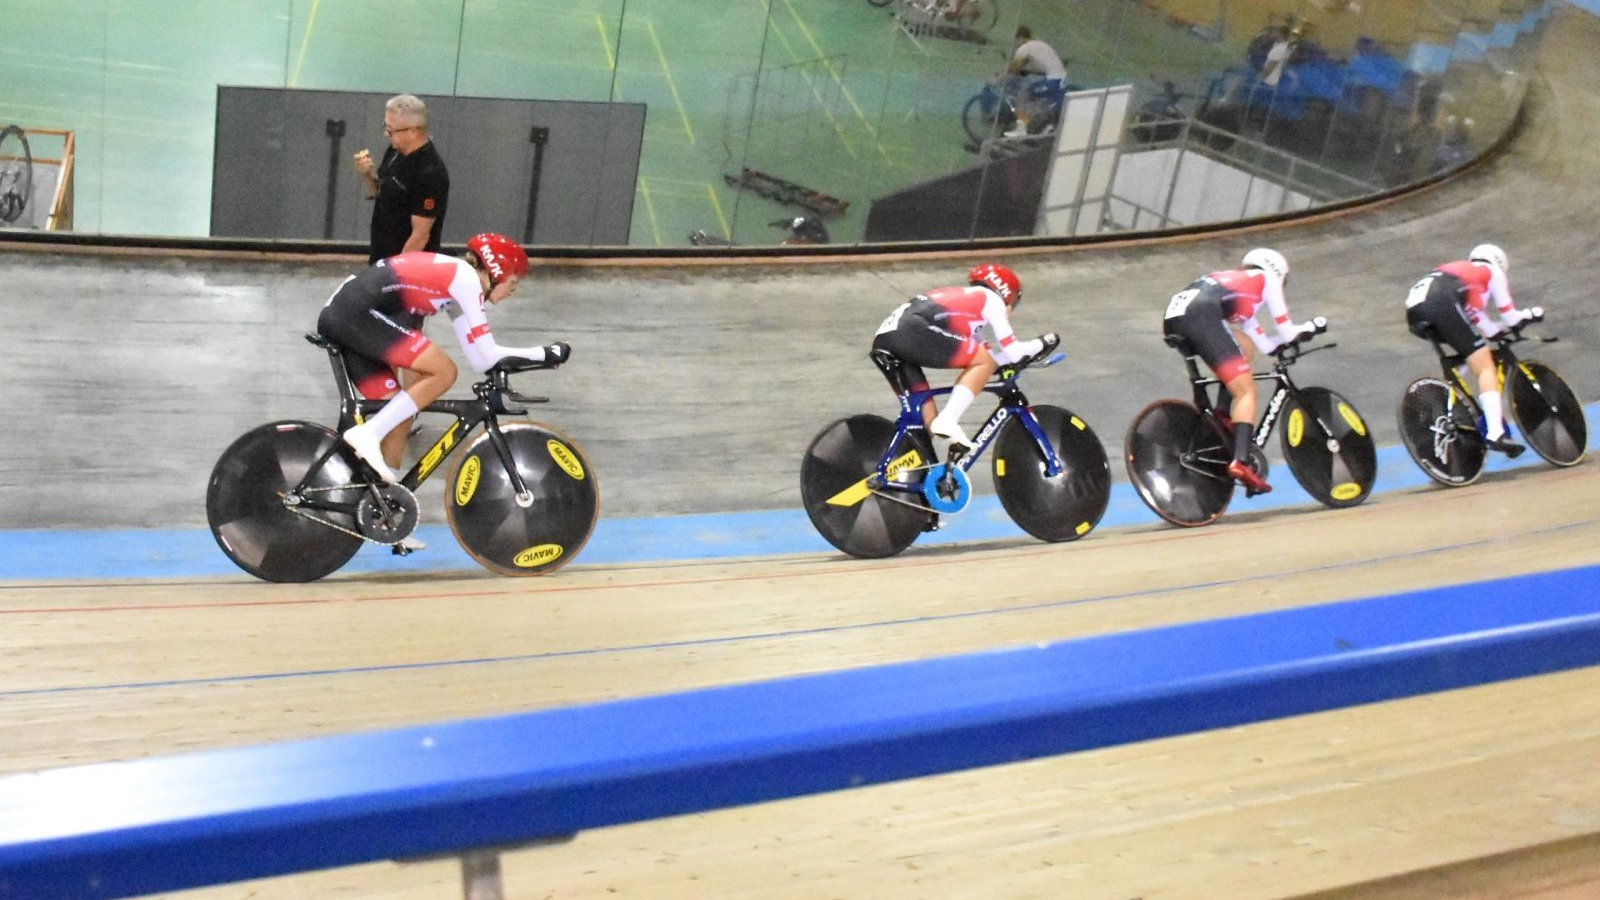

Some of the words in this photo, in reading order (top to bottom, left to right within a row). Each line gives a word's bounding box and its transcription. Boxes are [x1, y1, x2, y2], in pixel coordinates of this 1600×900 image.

[480, 244, 503, 278] KASK
[984, 271, 1011, 298] KASK
[553, 447, 578, 473] MAVIC
[461, 464, 476, 498] MAVIC
[523, 548, 554, 562] MAVIC
